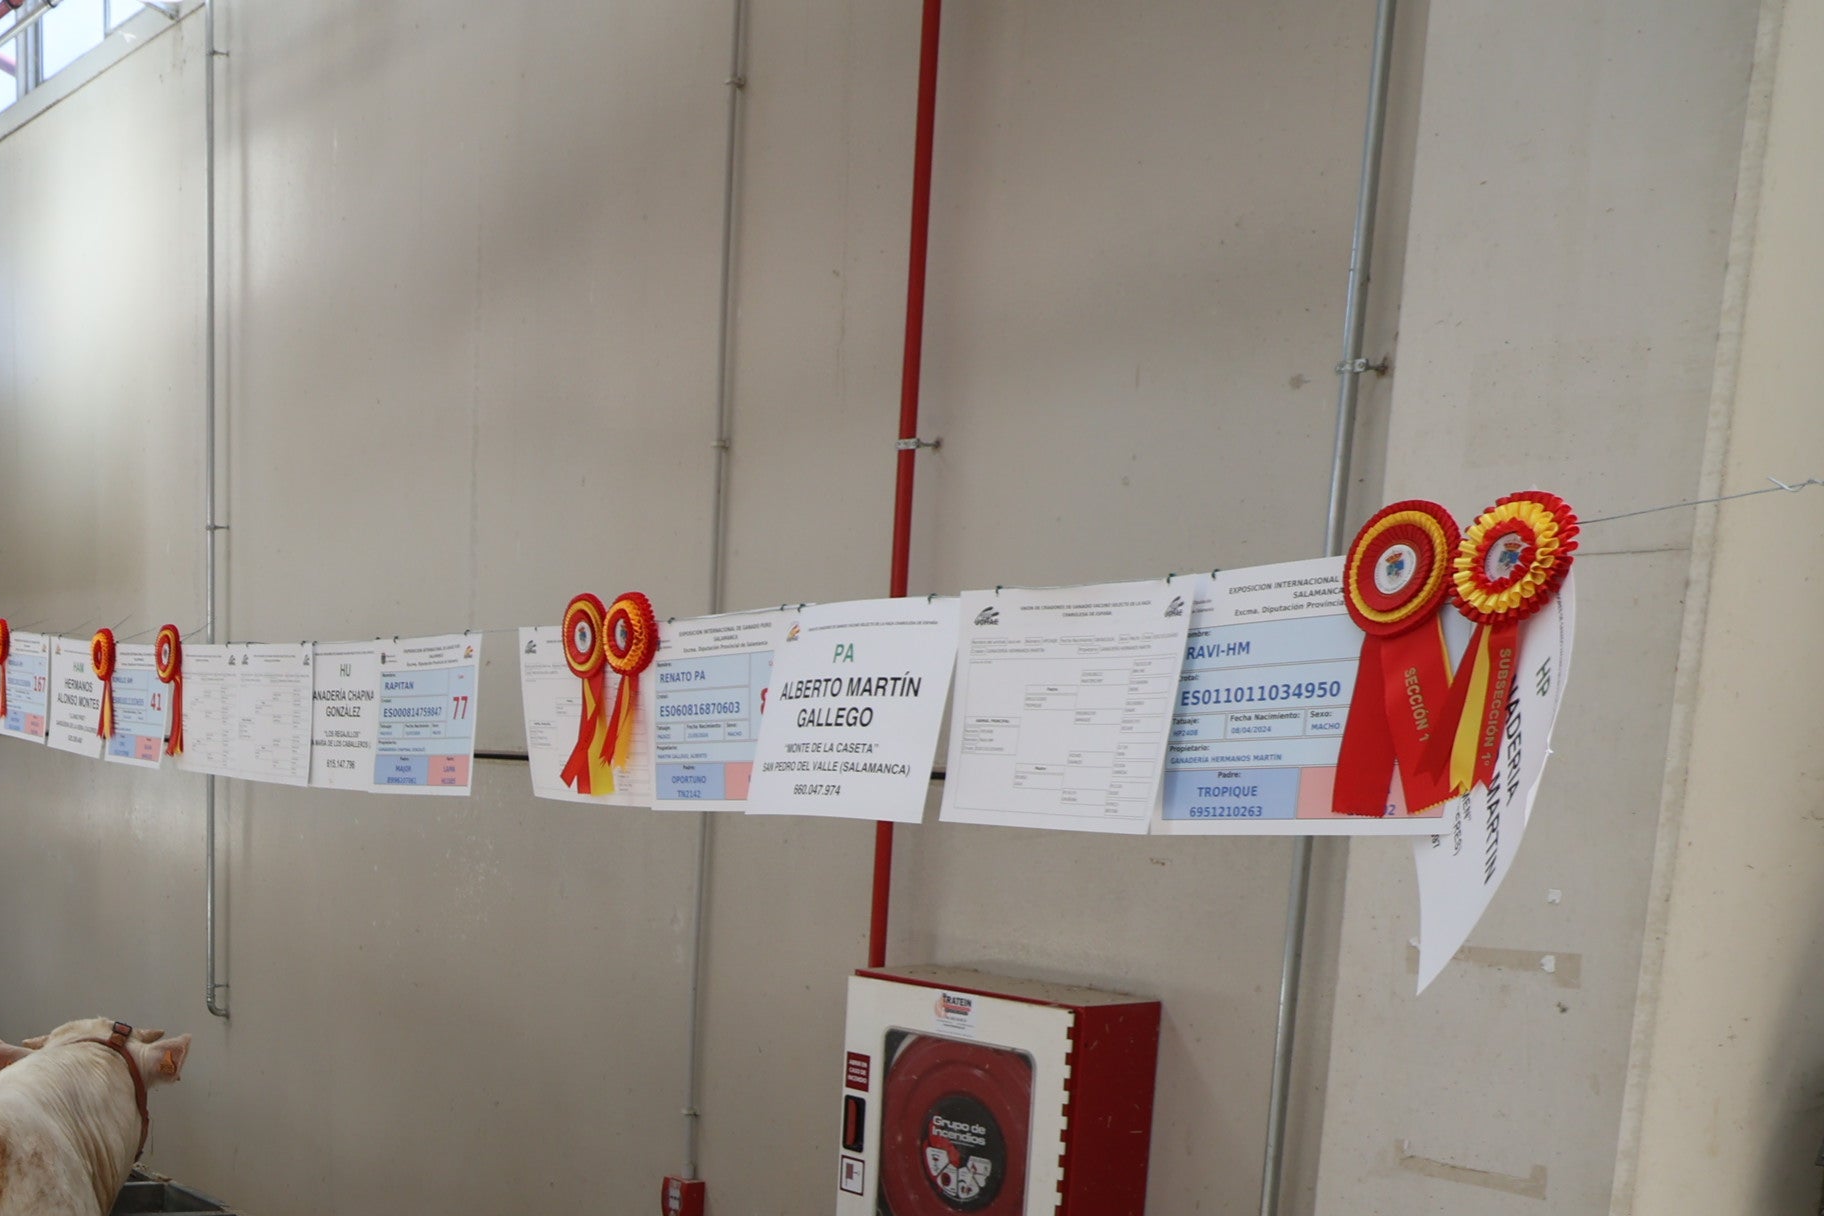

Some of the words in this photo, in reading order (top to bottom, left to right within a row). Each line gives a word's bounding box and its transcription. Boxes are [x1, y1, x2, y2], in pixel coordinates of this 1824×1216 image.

[1228, 583, 1272, 595] EXPOSICION
[1274, 576, 1339, 589] INTERNACIONAL
[1293, 587, 1345, 599] SALAMANCA
[1234, 608, 1259, 617] Excma.
[1261, 603, 1304, 615] Diputacion
[1306, 600, 1346, 609] Provincia
[679, 629, 703, 638] EXPOSICION
[704, 626, 735, 635] INTERNACIONAL
[742, 623, 760, 631] GANADO
[713, 634, 738, 642] SALAMANCA
[1187, 630, 1211, 638] ombre:
[833, 642, 855, 664] PA
[1186, 641, 1251, 660] RAVI-HM
[340, 663, 352, 677] HU
[660, 671, 693, 683] RENATO
[694, 670, 706, 681] PA
[1536, 657, 1551, 698] HP
[64, 678, 94, 693] HERMANOS
[384, 681, 414, 690] RAPITAN
[1180, 674, 1200, 682] rotal:
[780, 677, 843, 701] ALBERTO
[846, 671, 922, 698] MARTÍN
[1180, 680, 1341, 707] ES011011034950
[150, 692, 162, 711] 41
[312, 688, 346, 701] ANADERÍA
[1404, 667, 1430, 731] SECCIÓN
[1483, 648, 1512, 749] SUBSECCIÓN
[78, 696, 100, 710] MONTES
[326, 703, 361, 718] GONZÁLEZ
[453, 695, 469, 720] 77
[659, 701, 741, 717] ES060816870603
[797, 706, 874, 728] GALLEGO
[1172, 717, 1200, 726] Tatuaje:
[1230, 714, 1252, 722] Fecha
[1254, 711, 1301, 721] Nacimiento:
[1310, 710, 1333, 718] Sexo:
[1311, 722, 1341, 730] MACHO
[784, 742, 810, 753] "MONTE
[811, 742, 823, 753] DE
[824, 742, 835, 753] LA
[836, 742, 879, 754] CASETA"
[1169, 744, 1211, 752] Propietario:
[1210, 754, 1251, 763] HERMANOS
[762, 761, 774, 772] SAN
[775, 761, 796, 772] PEDRO
[796, 761, 810, 772] DEL
[812, 761, 839, 772] VALLE
[840, 761, 911, 777] (SALAMANCA)
[671, 775, 707, 784] OPORTUNO
[793, 784, 841, 796] 660.047.974
[1197, 786, 1258, 798] TROPIQUE
[1189, 806, 1263, 818] 6951210263
[932, 1115, 969, 1131] Grupo
[971, 1124, 986, 1135] de
[932, 1126, 986, 1146] Incendios
